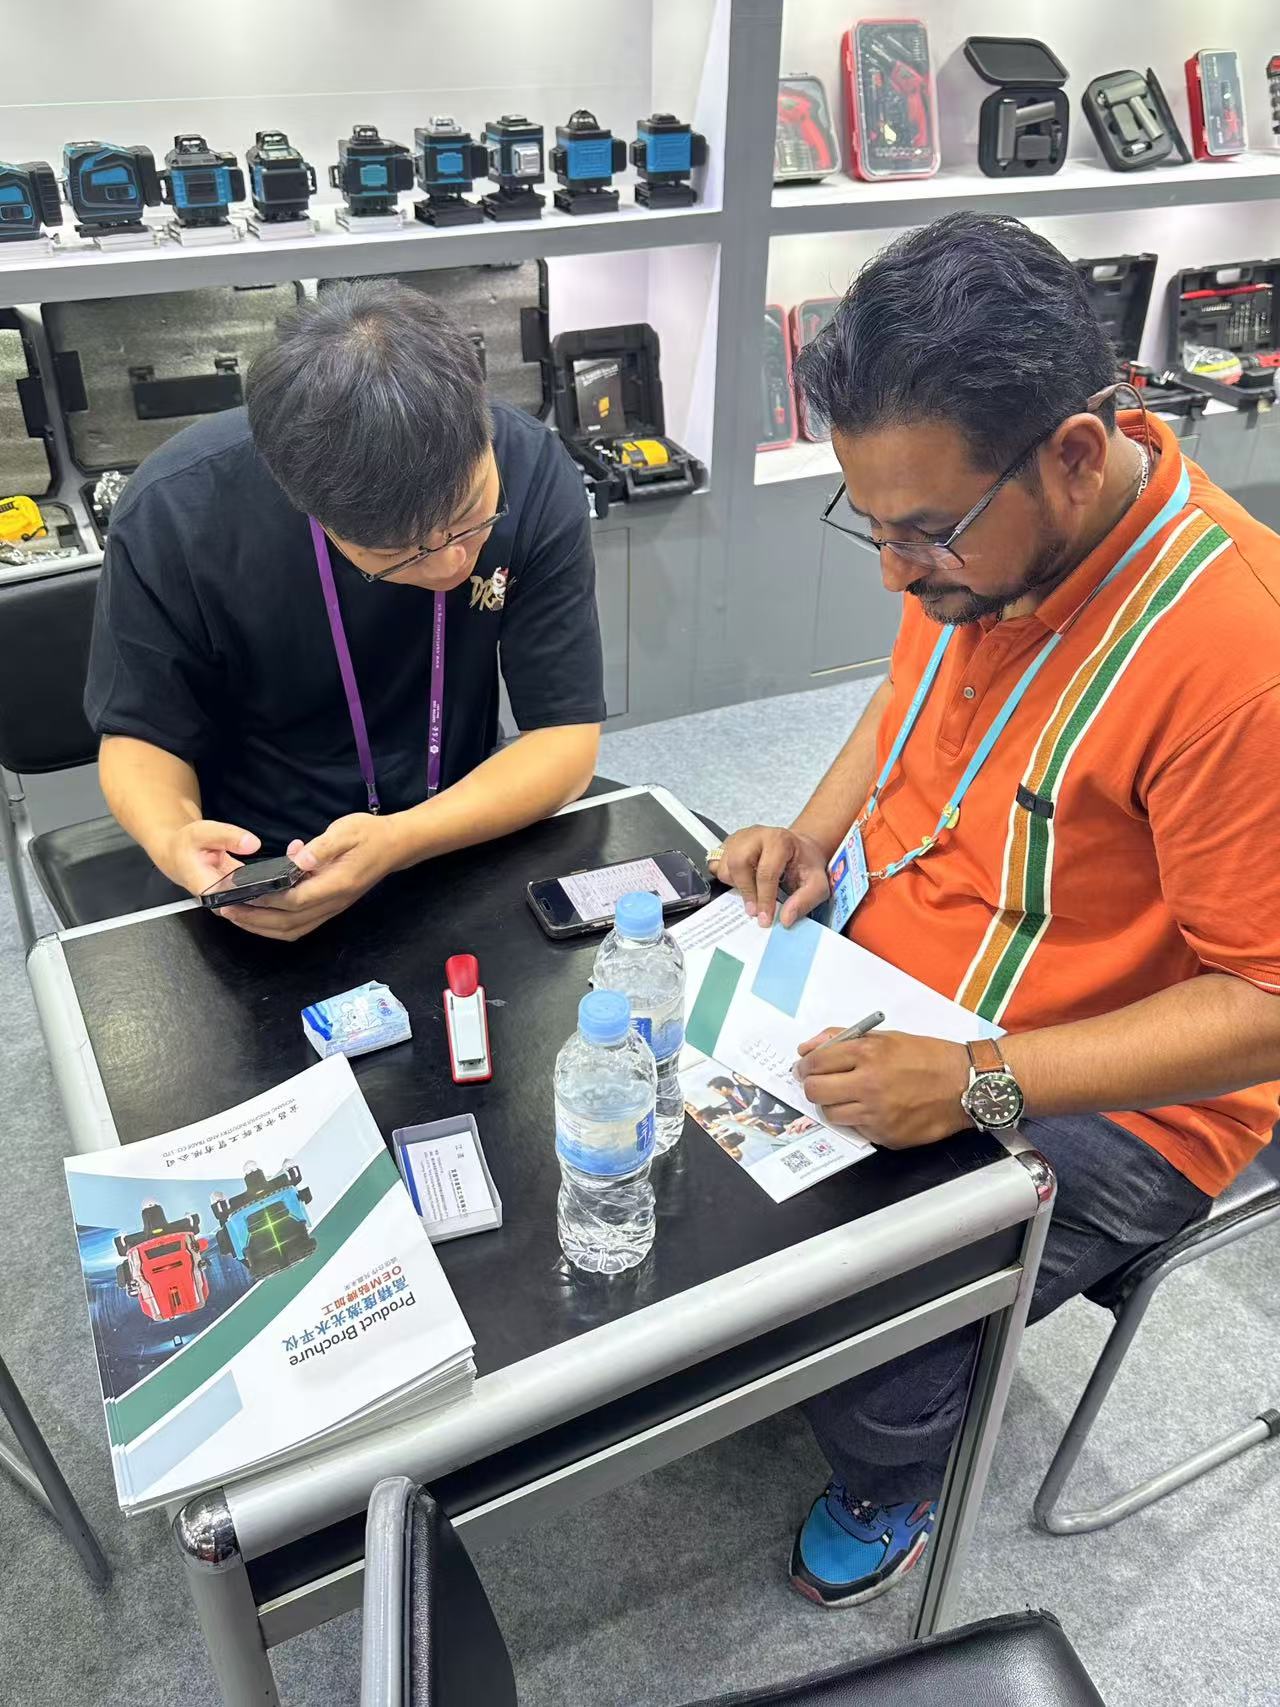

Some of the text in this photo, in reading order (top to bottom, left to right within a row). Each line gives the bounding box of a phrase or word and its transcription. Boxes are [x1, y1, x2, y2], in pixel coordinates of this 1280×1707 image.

[281, 1275, 410, 1352] 高精度激光水平仪
[321, 1265, 402, 1316] OEM贴牌加工
[289, 1291, 417, 1366] Product Brochure
